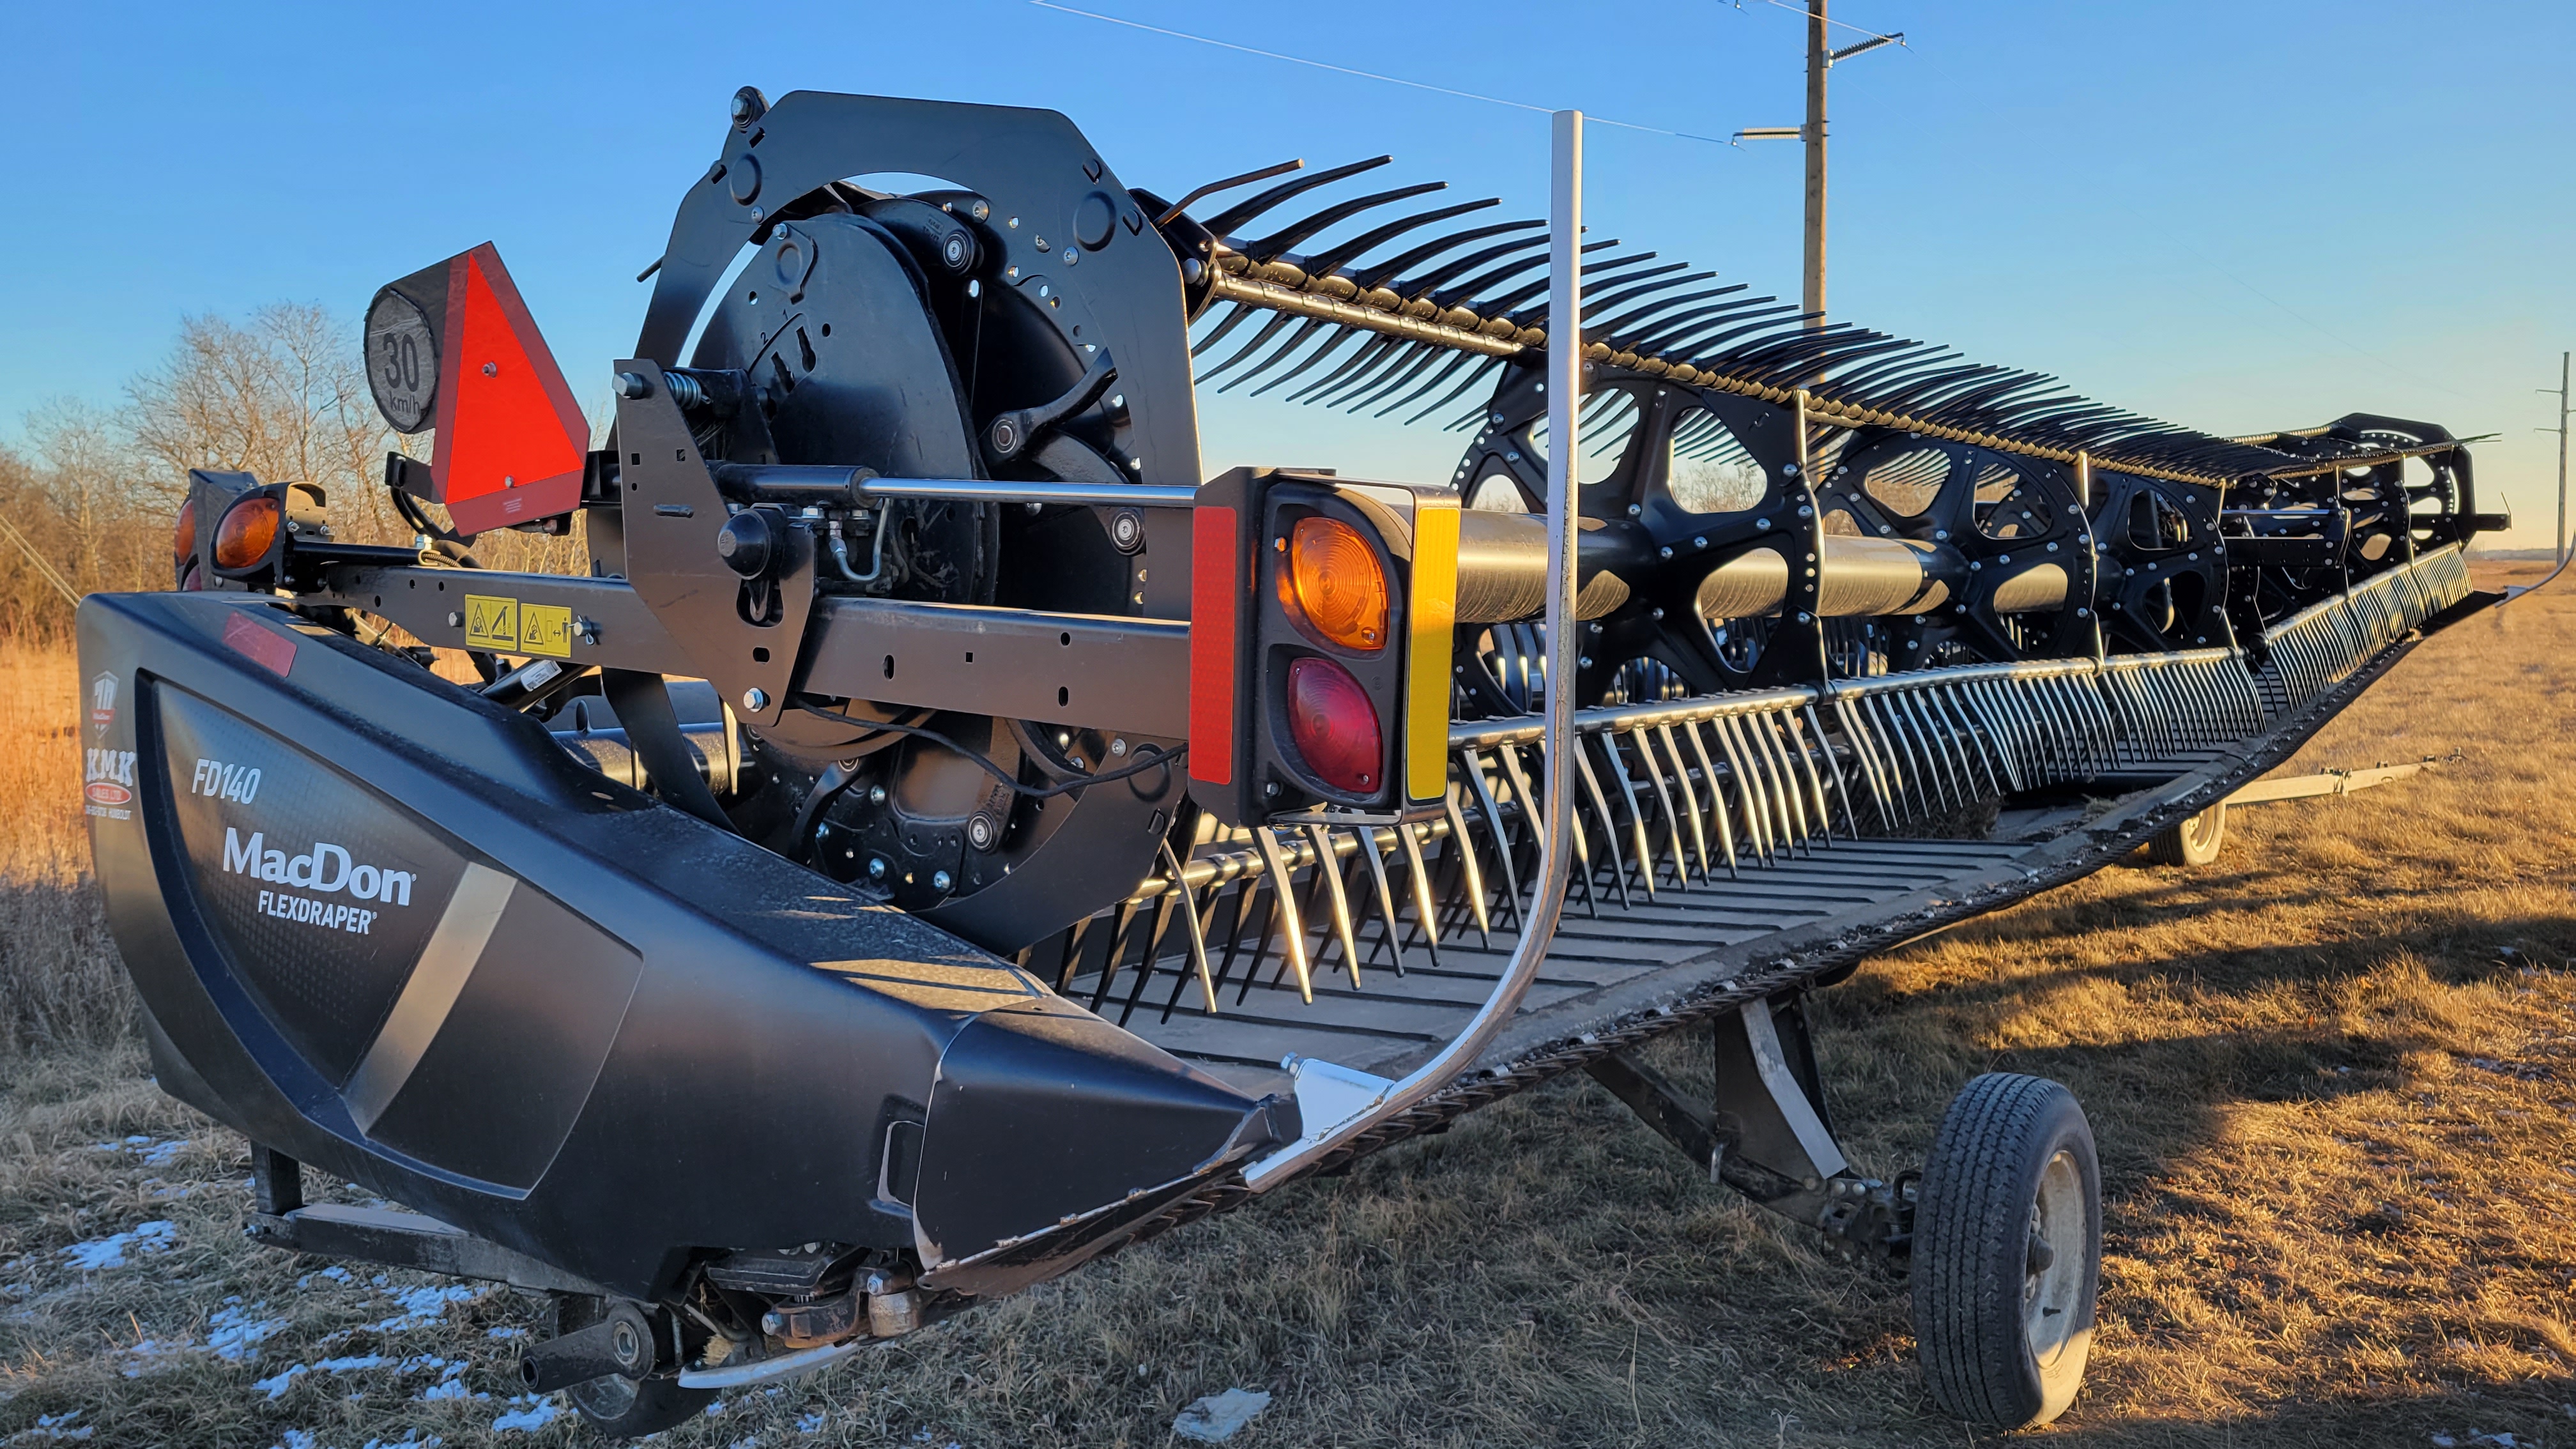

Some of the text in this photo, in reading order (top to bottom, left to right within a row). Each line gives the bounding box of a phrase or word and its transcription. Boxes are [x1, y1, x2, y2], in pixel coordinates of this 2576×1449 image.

[383, 332, 420, 392] 30
[390, 390, 421, 415] km/h
[192, 758, 261, 805] FD140
